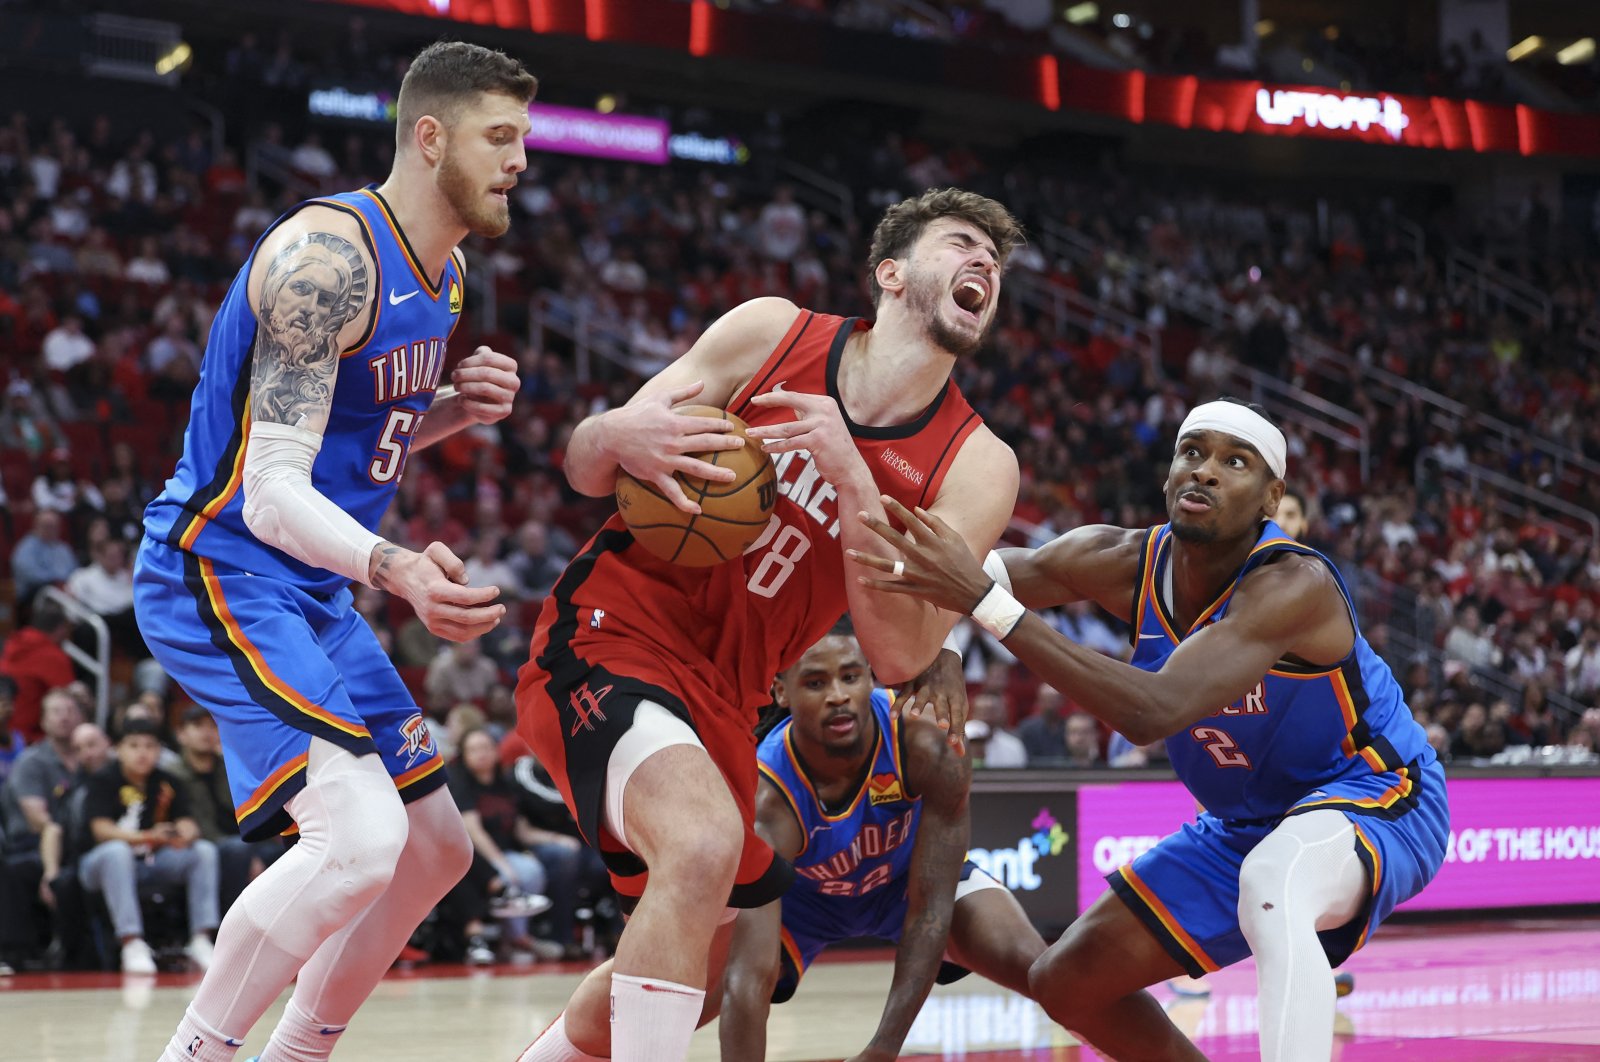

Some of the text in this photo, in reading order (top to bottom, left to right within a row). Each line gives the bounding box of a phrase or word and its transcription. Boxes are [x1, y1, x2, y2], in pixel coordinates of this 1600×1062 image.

[881, 448, 924, 481] MEMORIAL
[881, 454, 921, 485] HERMANN
[1191, 727, 1251, 769] 2
[1457, 828, 1493, 863] OF
[1494, 827, 1543, 862] THE
[819, 864, 891, 897] 22
[967, 837, 1042, 891] ant
